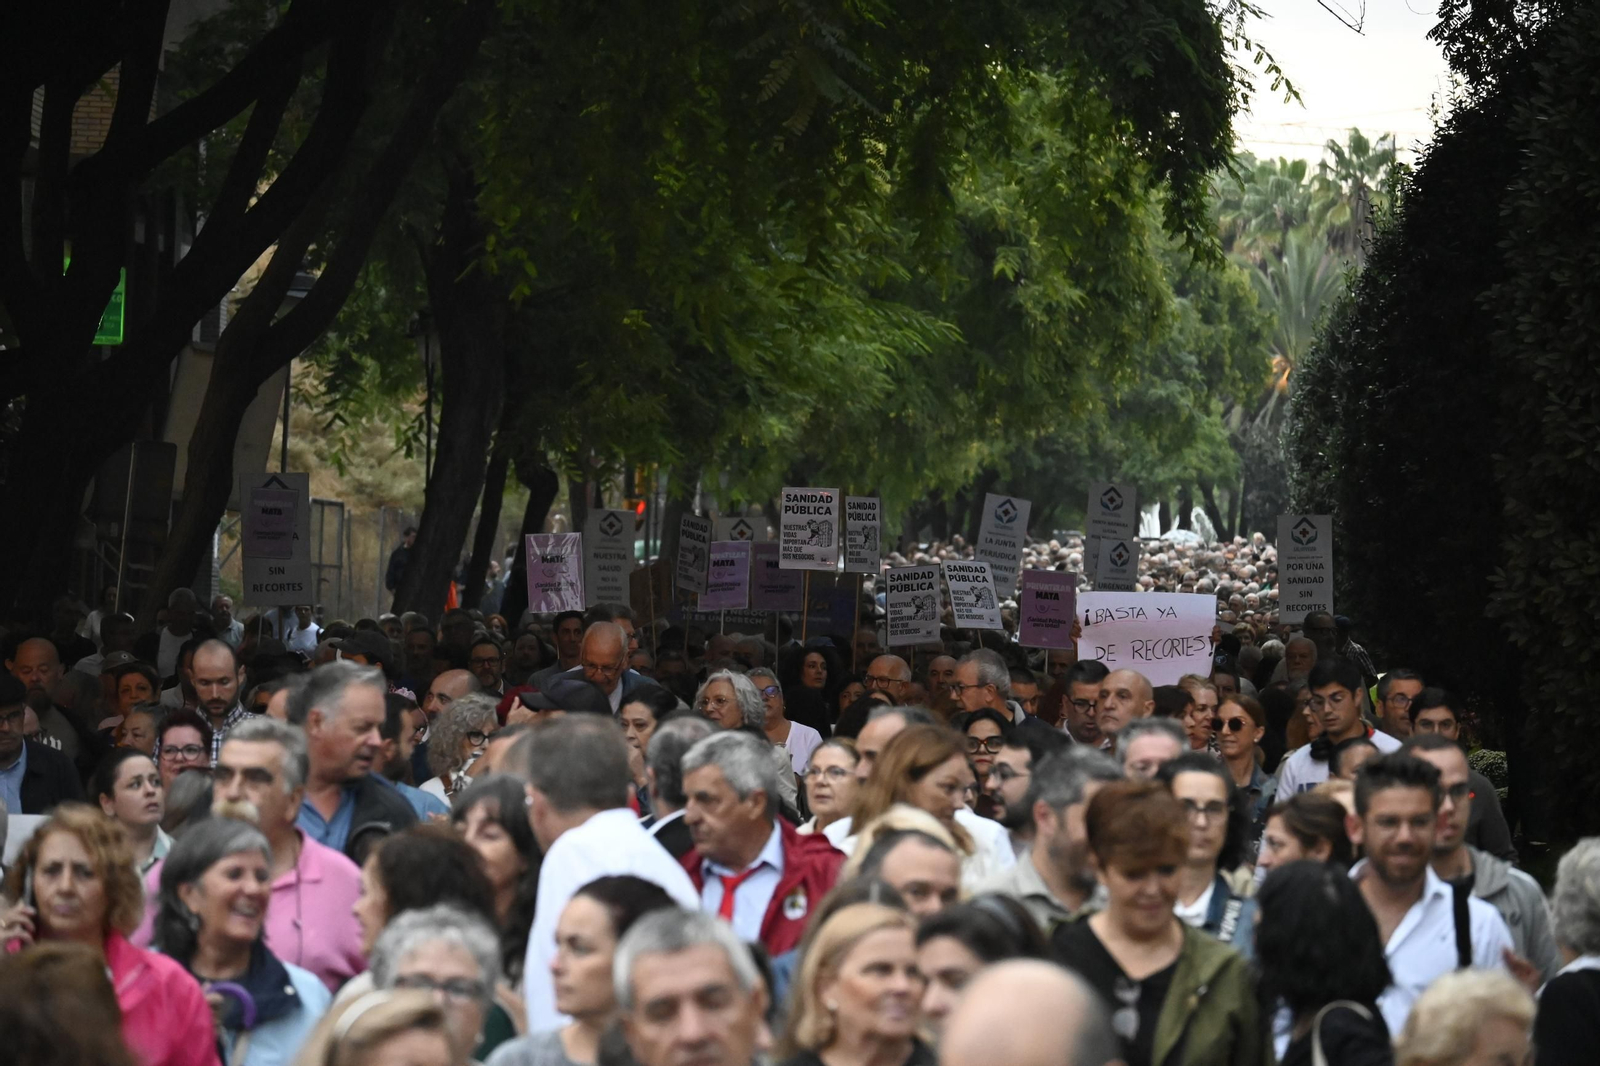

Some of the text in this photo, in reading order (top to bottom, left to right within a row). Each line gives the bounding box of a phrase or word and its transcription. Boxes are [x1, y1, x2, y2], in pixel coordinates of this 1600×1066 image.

[785, 494, 833, 504] SANIDAD
[784, 504, 832, 516] PÚBLICA
[848, 502, 876, 511] SANIDAD
[262, 508, 282, 516] MATA
[848, 512, 876, 522] PÚBLICA
[682, 519, 708, 533] SANIDAD
[994, 538, 1016, 548] JUNTA
[980, 549, 1017, 561] PERJUDICA
[268, 566, 285, 575] SIN
[946, 565, 986, 574] SANIDAD
[990, 564, 1015, 573] AMENTE
[890, 571, 934, 582] SANIDAD
[949, 574, 989, 583] PÚBLICA
[994, 574, 1009, 583] ALUD
[1287, 576, 1324, 584] SANIDAD
[252, 582, 303, 592] RECORTES
[890, 582, 934, 593] PÚBLICA
[1026, 582, 1071, 592] PRIVATIZAR
[1036, 591, 1059, 600] MATA
[1286, 604, 1327, 612] RECORTES
[1084, 606, 1177, 626] ¡BASTA YA
[1095, 636, 1213, 661] DE RECORTES!
